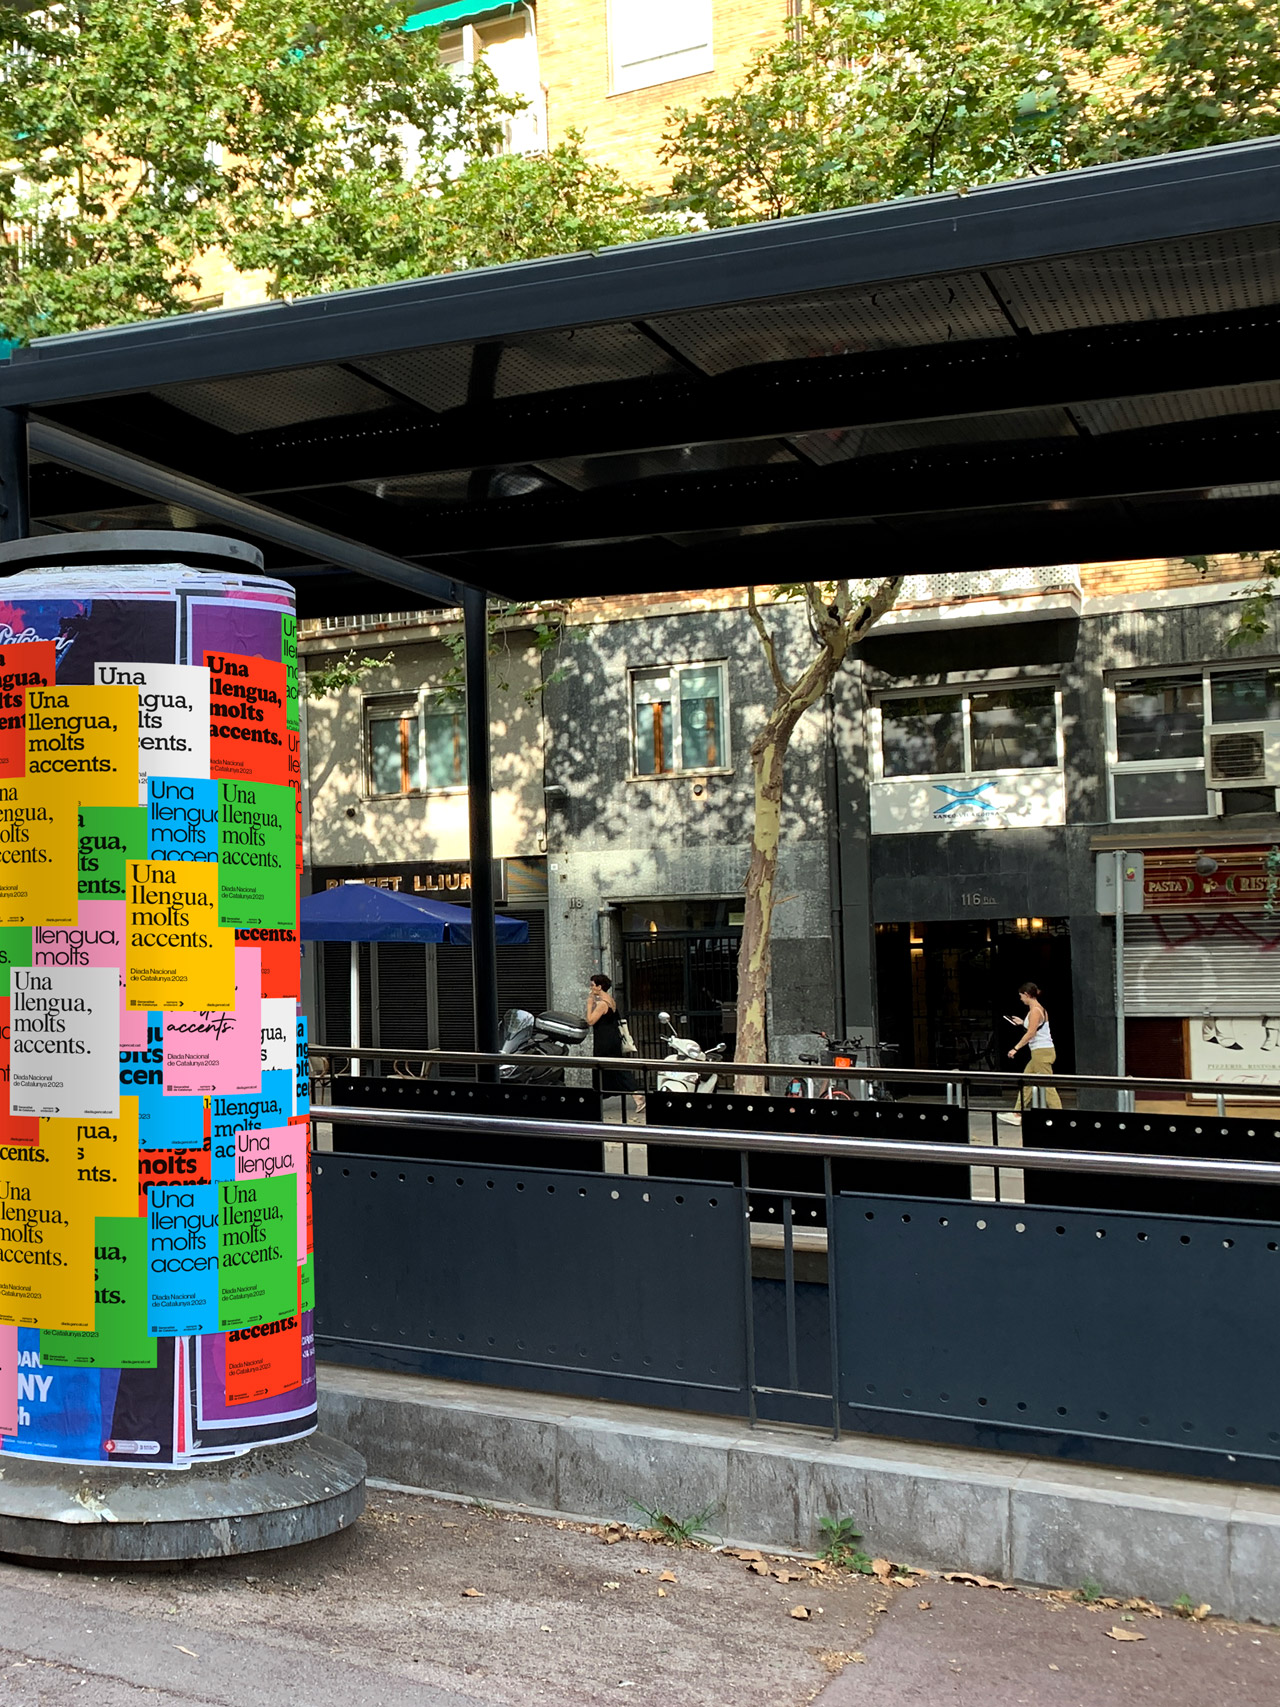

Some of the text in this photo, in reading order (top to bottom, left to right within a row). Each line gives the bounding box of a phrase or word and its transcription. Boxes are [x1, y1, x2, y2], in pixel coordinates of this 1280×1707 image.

[98, 667, 147, 685] Una
[207, 656, 249, 678] Una
[29, 692, 70, 710] Una
[210, 678, 282, 708] llengua,
[210, 702, 264, 722] molts
[29, 713, 118, 734] llengua,
[29, 734, 85, 752] molts
[138, 734, 192, 752] ents.
[210, 724, 282, 746] accents.
[29, 756, 117, 773] accents.
[151, 781, 194, 800] Una
[223, 783, 256, 805] Una
[222, 804, 282, 831] llengua,
[151, 826, 206, 843] molts
[222, 826, 265, 846] molts
[222, 851, 282, 868] accents.
[131, 864, 177, 884] Una
[1149, 881, 1183, 892] PASTA
[131, 885, 214, 910] llengua,
[961, 893, 981, 906] 116
[131, 907, 189, 926] molts
[35, 927, 120, 949] llengua,
[131, 931, 213, 948] accents.
[35, 947, 90, 965] molts
[14, 971, 52, 991] Una
[14, 992, 92, 1016] llengua,
[14, 1013, 66, 1033] molts
[167, 1012, 237, 1041] accents.
[14, 1037, 91, 1054] accents.
[175, 1060, 205, 1068] Catalunya
[214, 1099, 282, 1119] llengua,
[215, 1119, 261, 1137] molts
[238, 1135, 270, 1152] Una
[139, 1156, 197, 1174] molts
[238, 1154, 295, 1174] llengua,
[152, 1190, 194, 1208] Una
[223, 1186, 257, 1205] Una
[223, 1205, 283, 1227] llengua,
[152, 1233, 206, 1251] molts
[223, 1225, 266, 1247] molts
[222, 1245, 282, 1268] accents.
[229, 1316, 298, 1342] accents.
